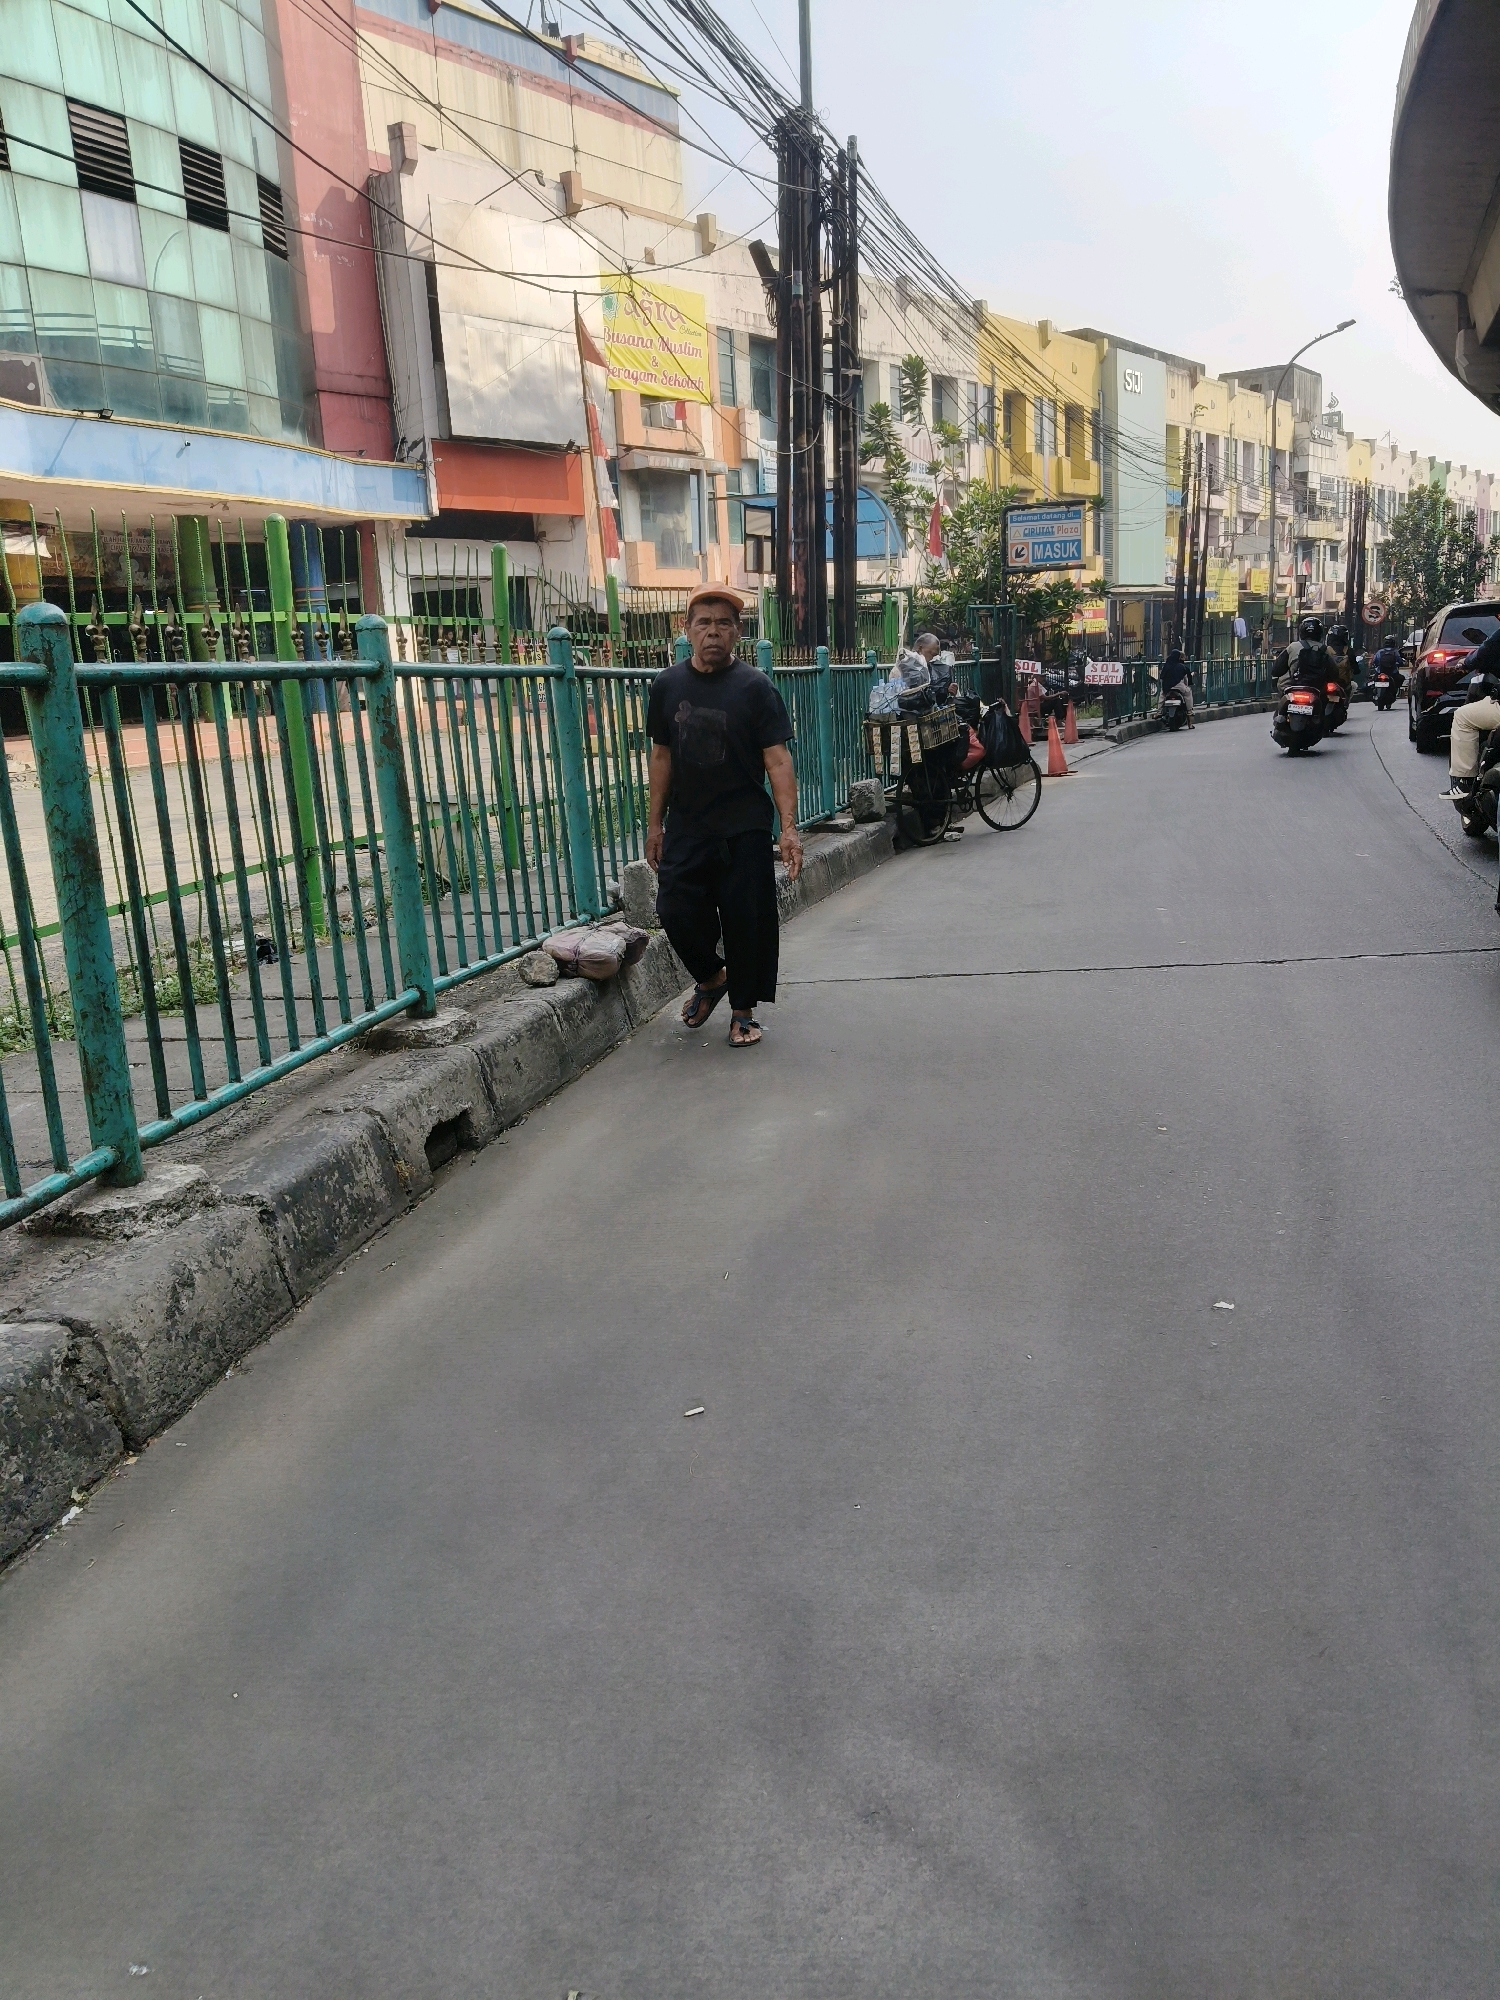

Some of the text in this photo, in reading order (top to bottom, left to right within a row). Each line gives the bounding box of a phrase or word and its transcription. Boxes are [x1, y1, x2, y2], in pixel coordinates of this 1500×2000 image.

[603, 326, 703, 358] Busana Muslim
[651, 356, 659, 367] &
[660, 369, 705, 391] Sekolah
[1012, 514, 1040, 522] Selamat
[1041, 513, 1066, 521] datang
[1056, 525, 1079, 535] Plaza
[1034, 542, 1079, 560] MASUK
[1015, 660, 1039, 673] SOL
[1090, 663, 1119, 673] SOL
